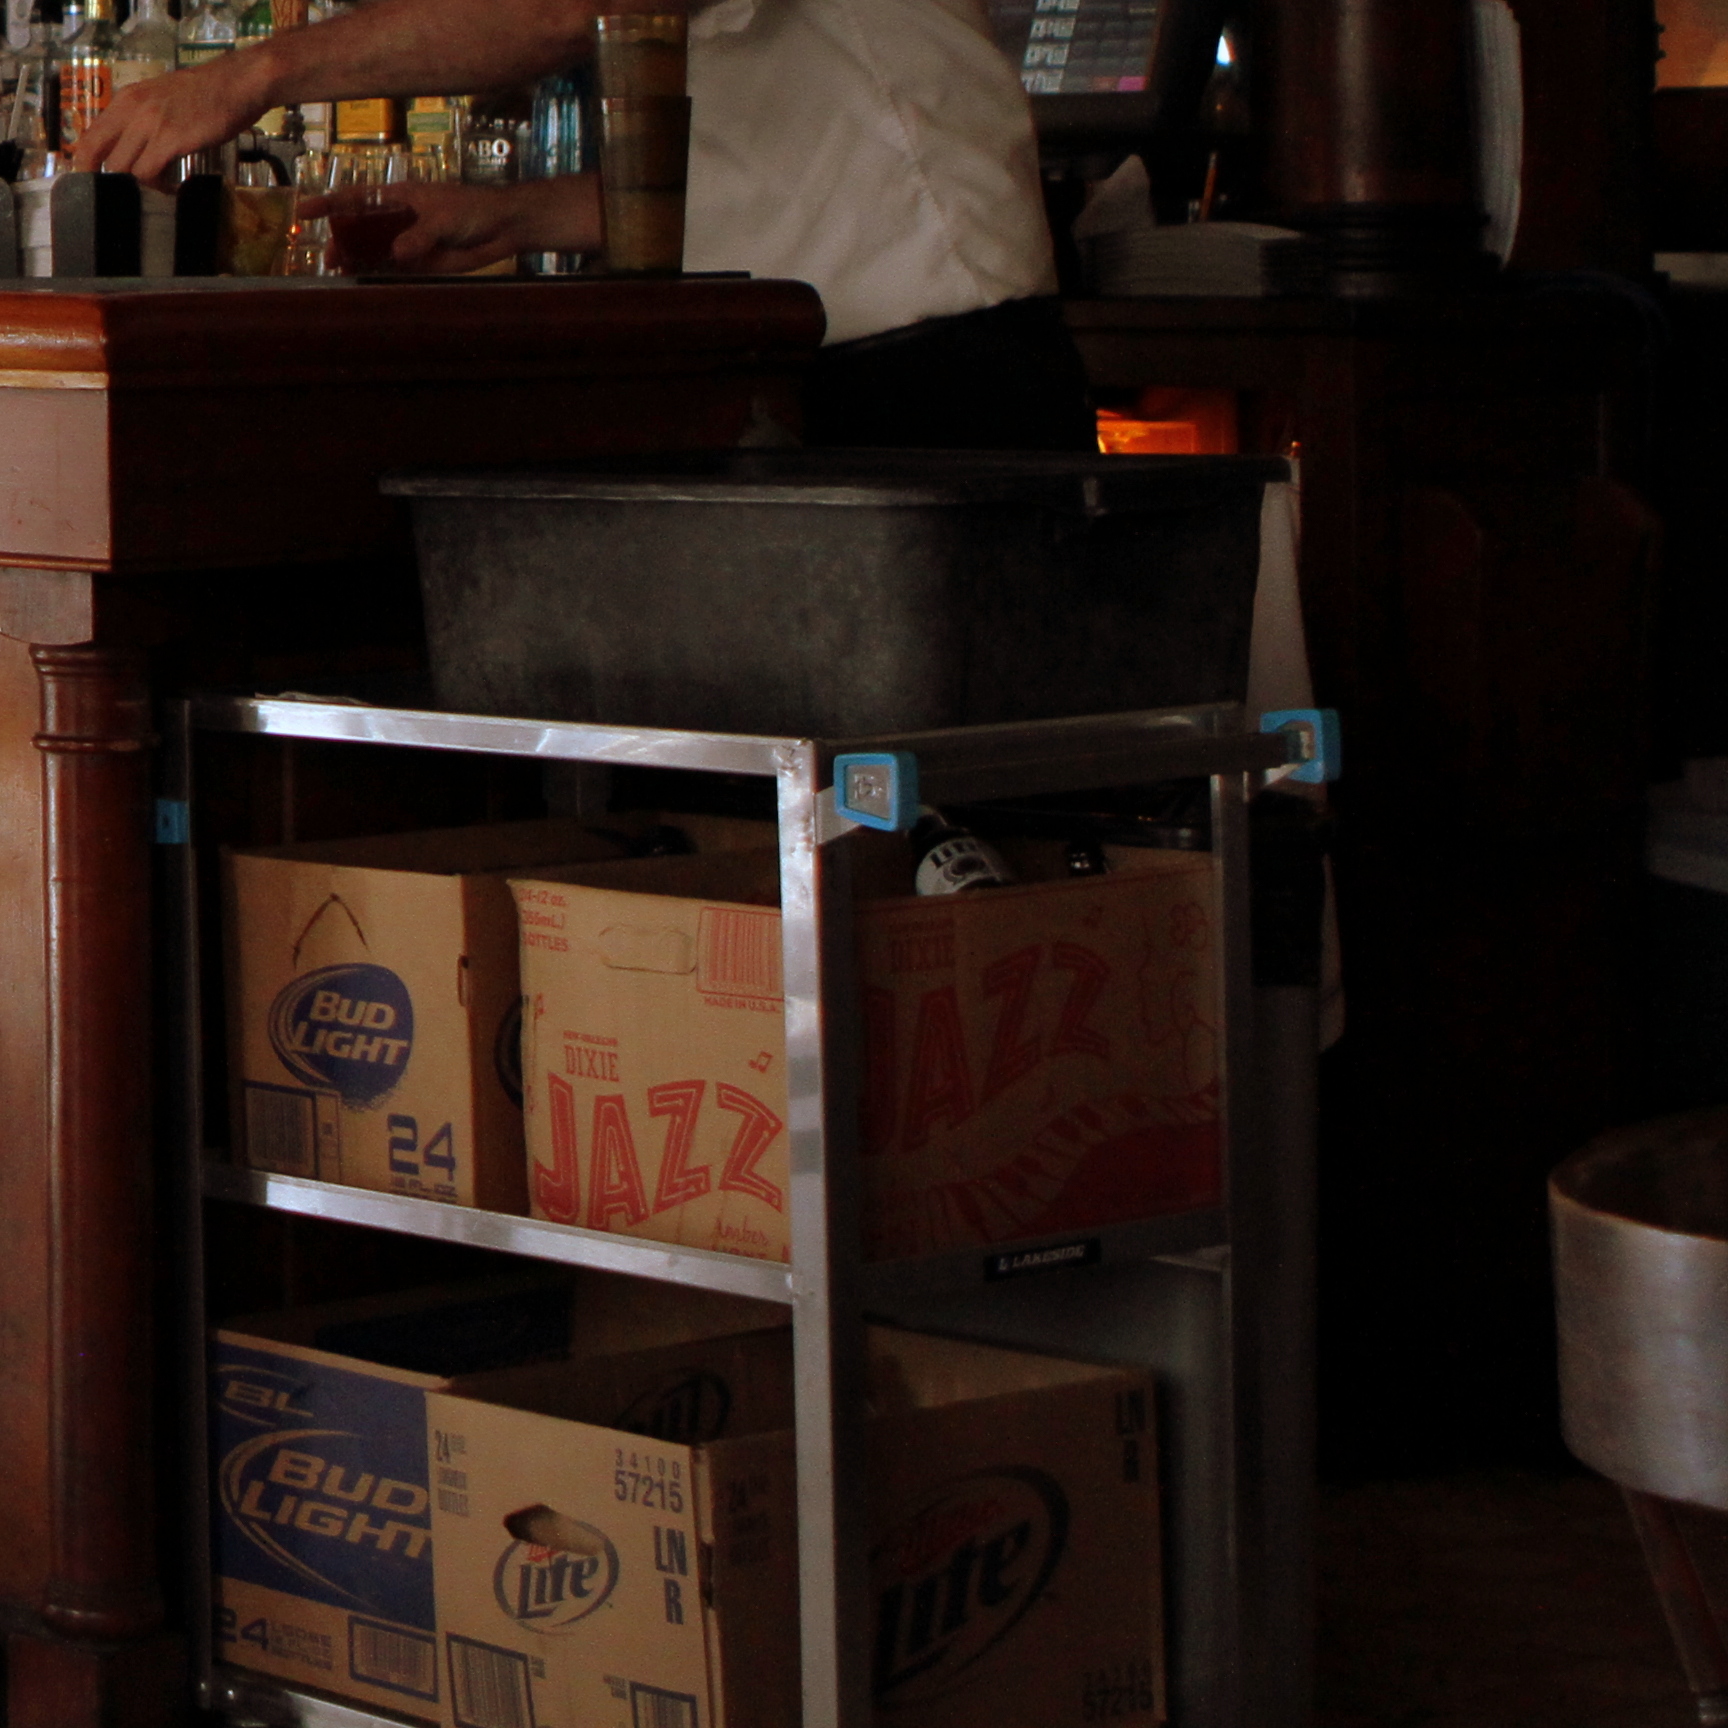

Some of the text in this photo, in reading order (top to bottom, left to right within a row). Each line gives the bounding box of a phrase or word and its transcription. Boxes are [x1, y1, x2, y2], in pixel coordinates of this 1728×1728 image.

[309, 989, 396, 1032] BUD
[704, 996, 733, 1011] MADE
[289, 1020, 409, 1068] LIGHT
[564, 1043, 620, 1084] DIXIE
[386, 1112, 457, 1184] 24
[533, 1071, 784, 1232] JAZZ
[1011, 1244, 1086, 1269] LAKESIDE
[267, 1448, 430, 1517] BUD
[613, 1469, 685, 1515] 57215
[239, 1479, 433, 1560] LIGHT
[653, 1524, 688, 1578] LN
[515, 1554, 600, 1620] Lite
[663, 1577, 685, 1626] R
[873, 1518, 1032, 1700] Lite
